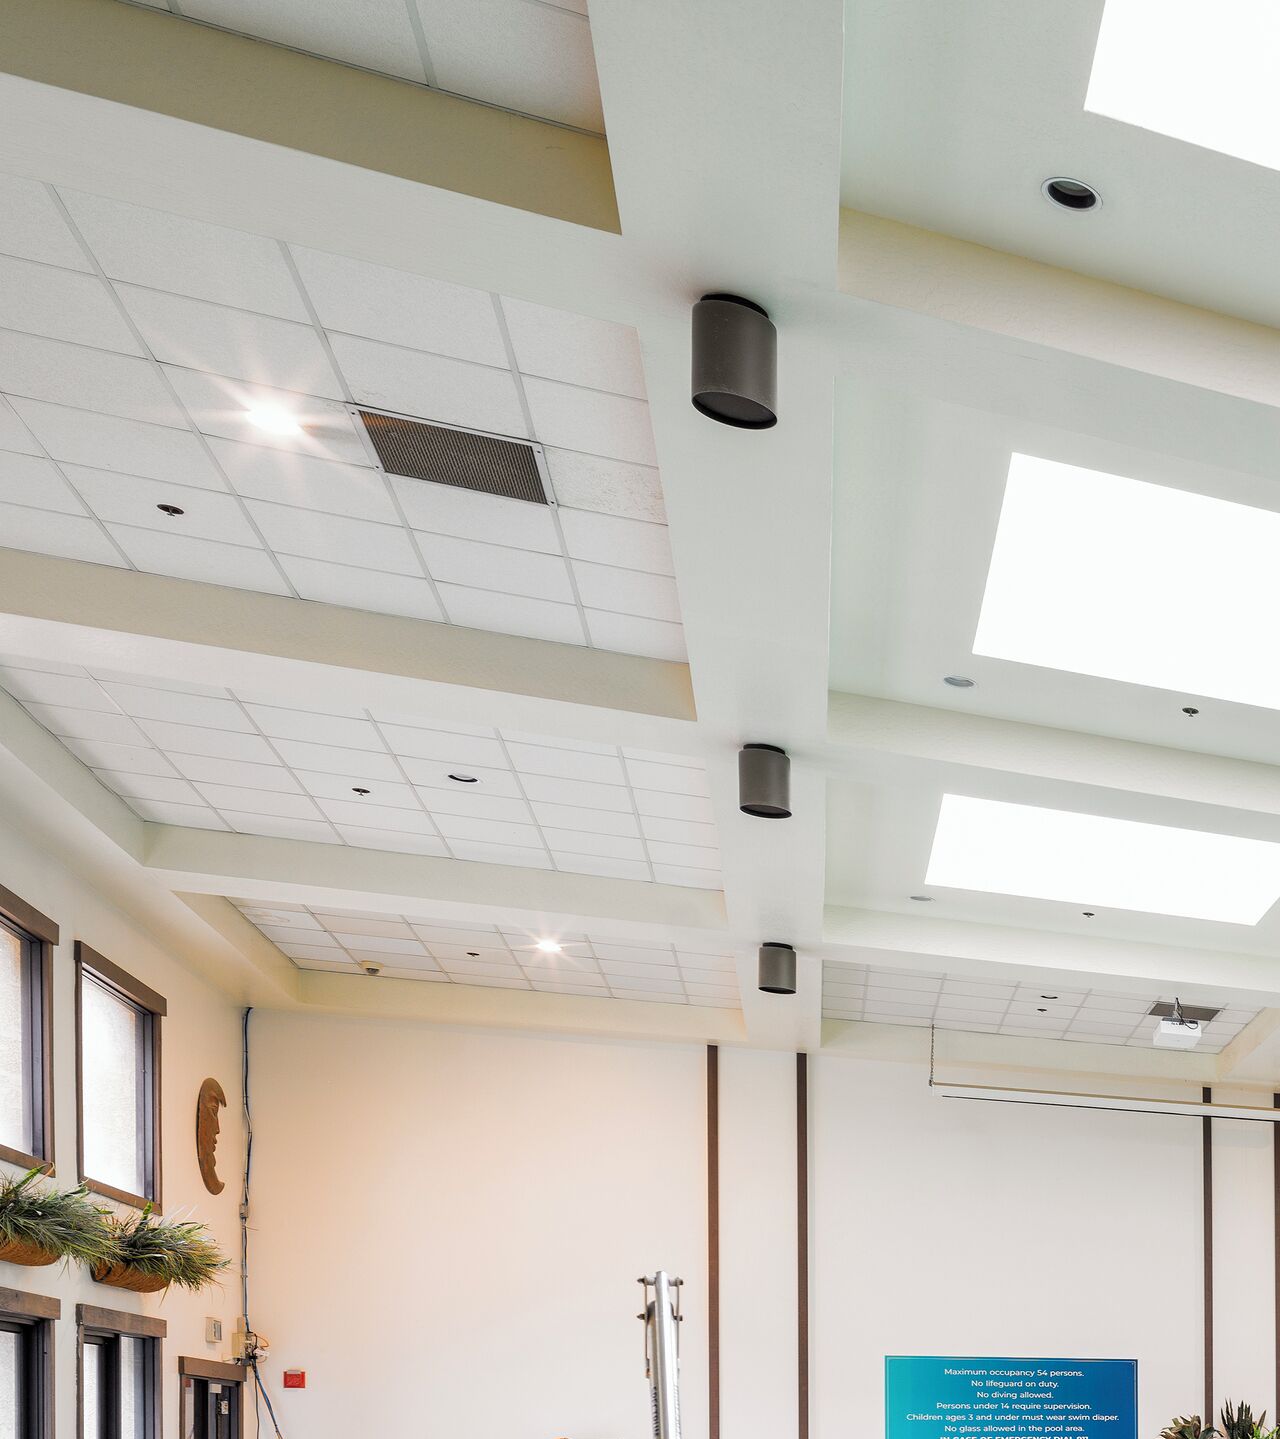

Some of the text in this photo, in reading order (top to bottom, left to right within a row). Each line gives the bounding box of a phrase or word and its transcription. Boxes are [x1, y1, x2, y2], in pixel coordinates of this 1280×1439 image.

[989, 1370, 1035, 1378] occupancy
[1050, 1370, 1085, 1378] persons.
[986, 1380, 1023, 1388] lifeguard
[1038, 1381, 1059, 1389] duty.
[991, 1392, 1017, 1400] diving
[1012, 1403, 1042, 1411] require
[1043, 1403, 1092, 1411] supervision.
[906, 1413, 943, 1421] Children
[1092, 1414, 1120, 1422] diaper.
[959, 1425, 981, 1434] glass
[1044, 1425, 1063, 1434] pool
